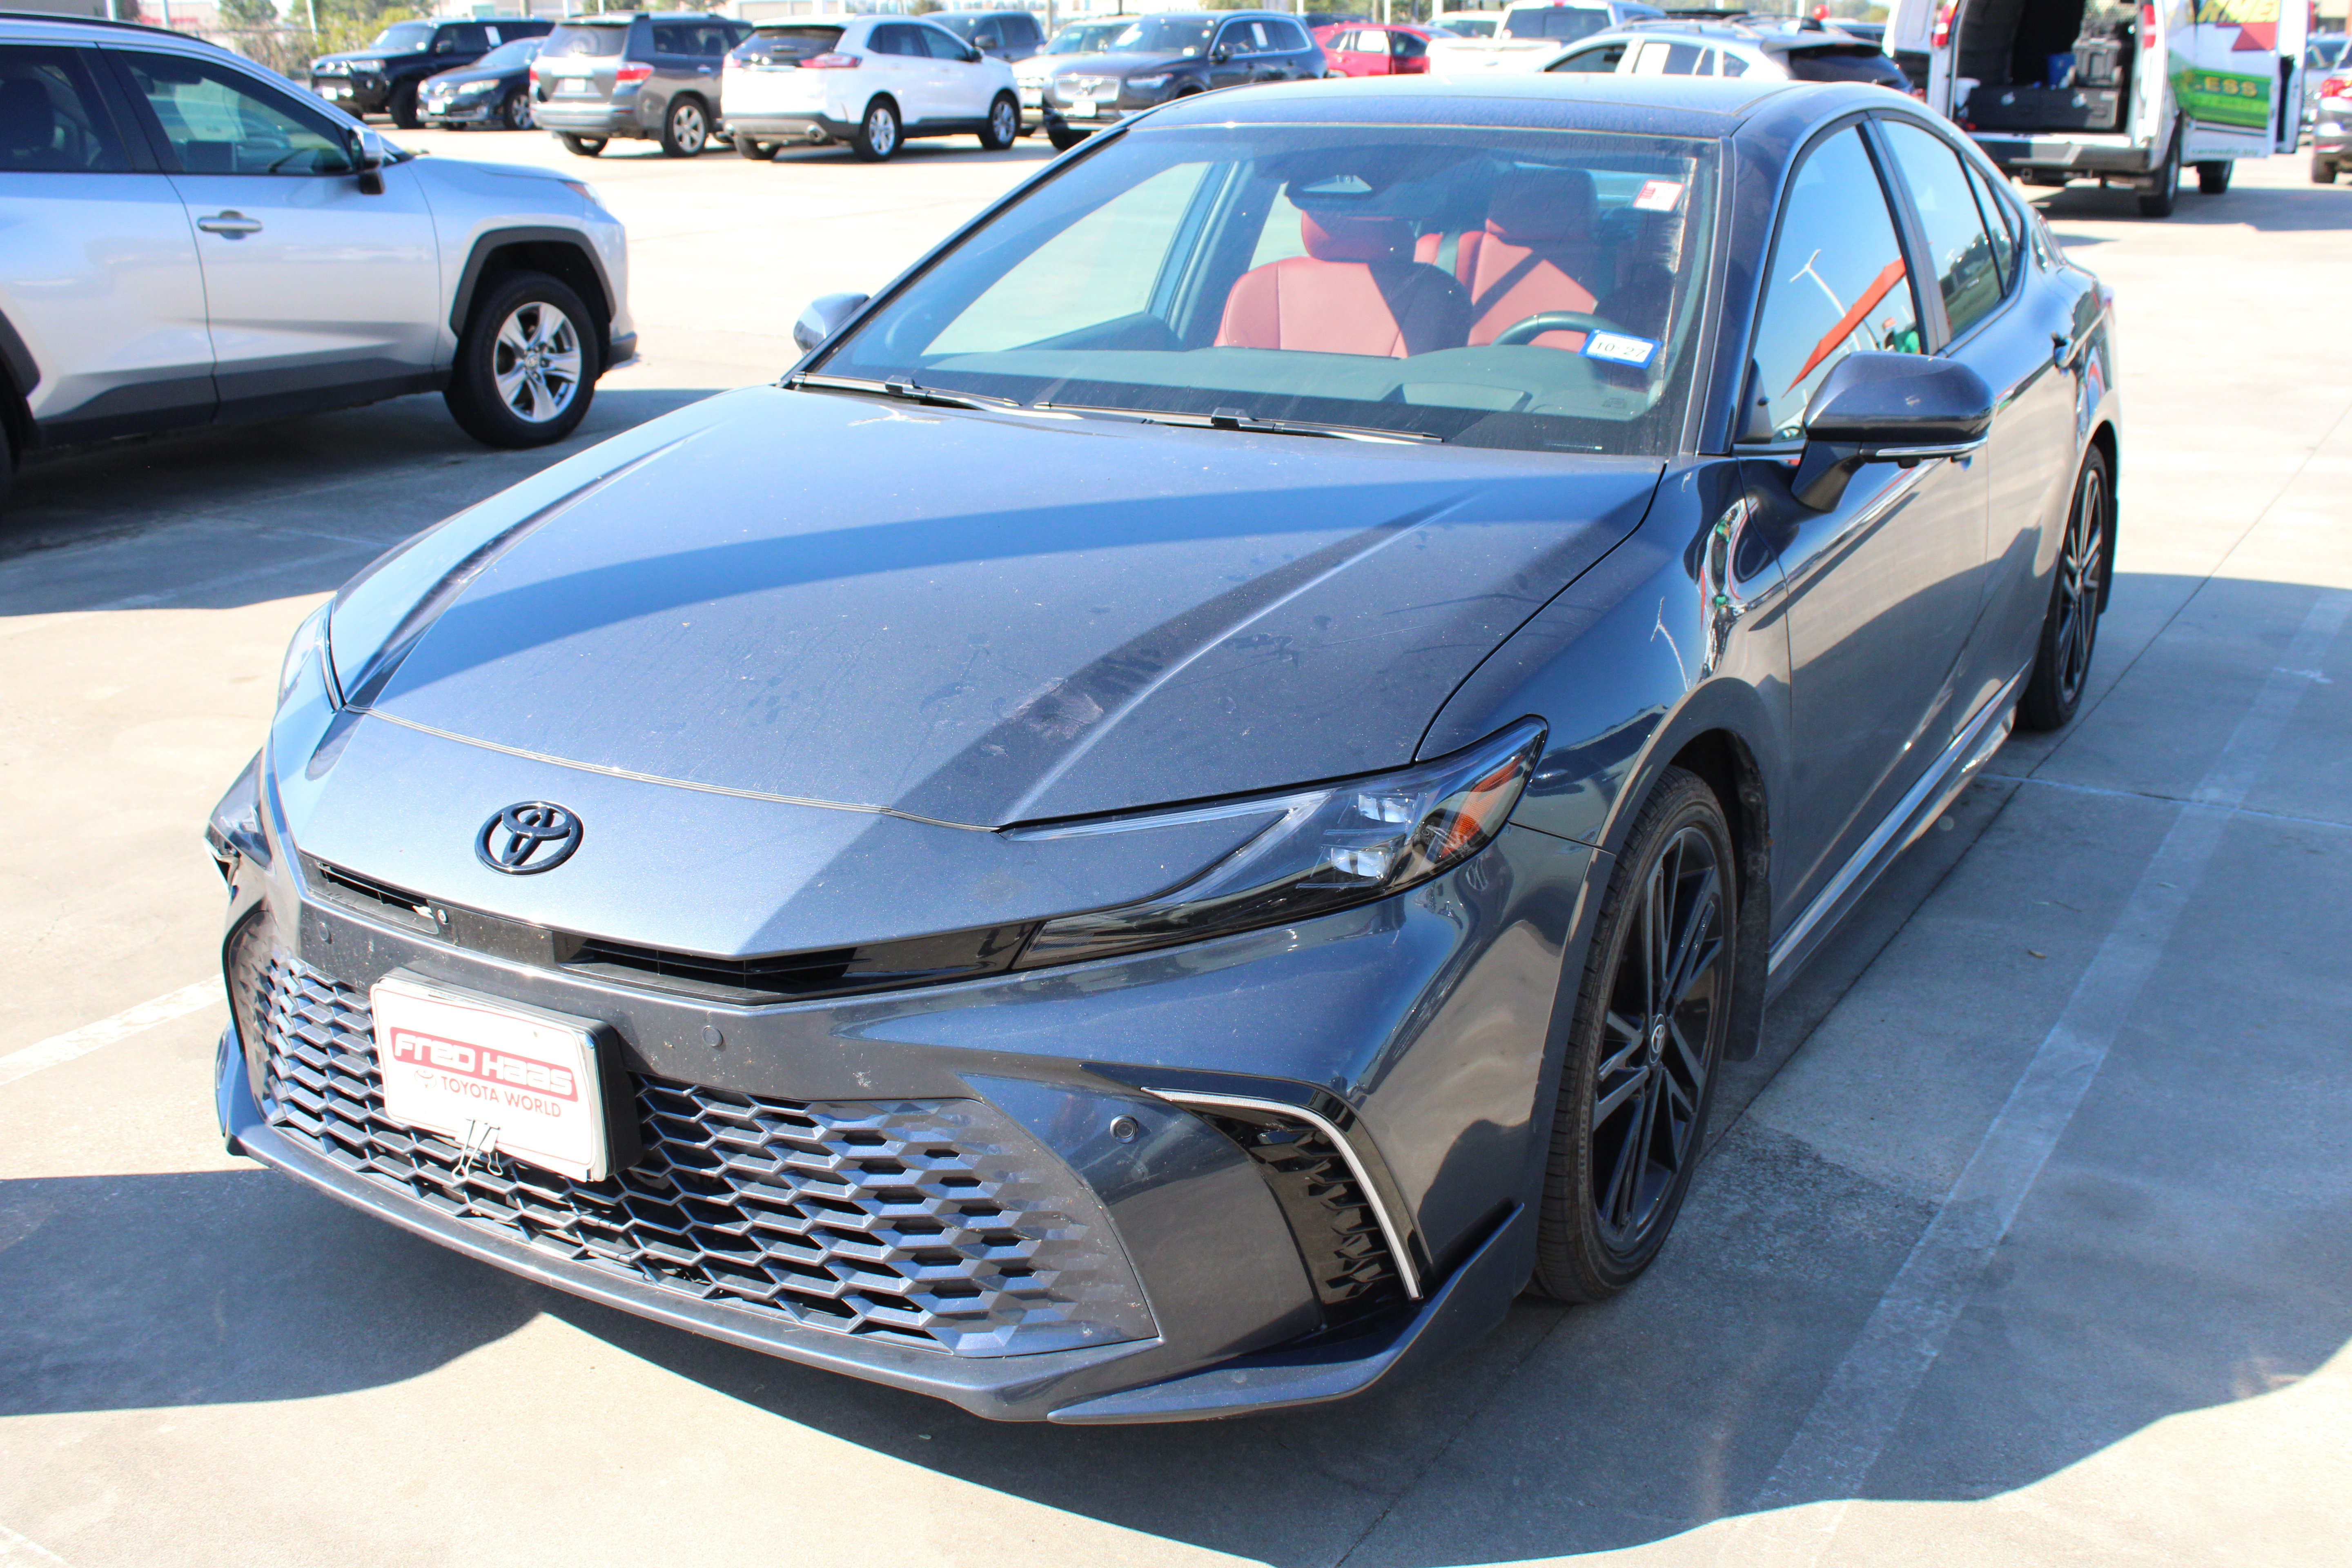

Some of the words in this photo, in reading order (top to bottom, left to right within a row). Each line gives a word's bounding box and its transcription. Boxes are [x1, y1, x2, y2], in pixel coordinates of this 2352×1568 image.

[1597, 342, 1615, 352] 10
[1623, 346, 1646, 357] 27
[441, 1076, 499, 1103] TOYOTA
[504, 1091, 561, 1117] WORLD
